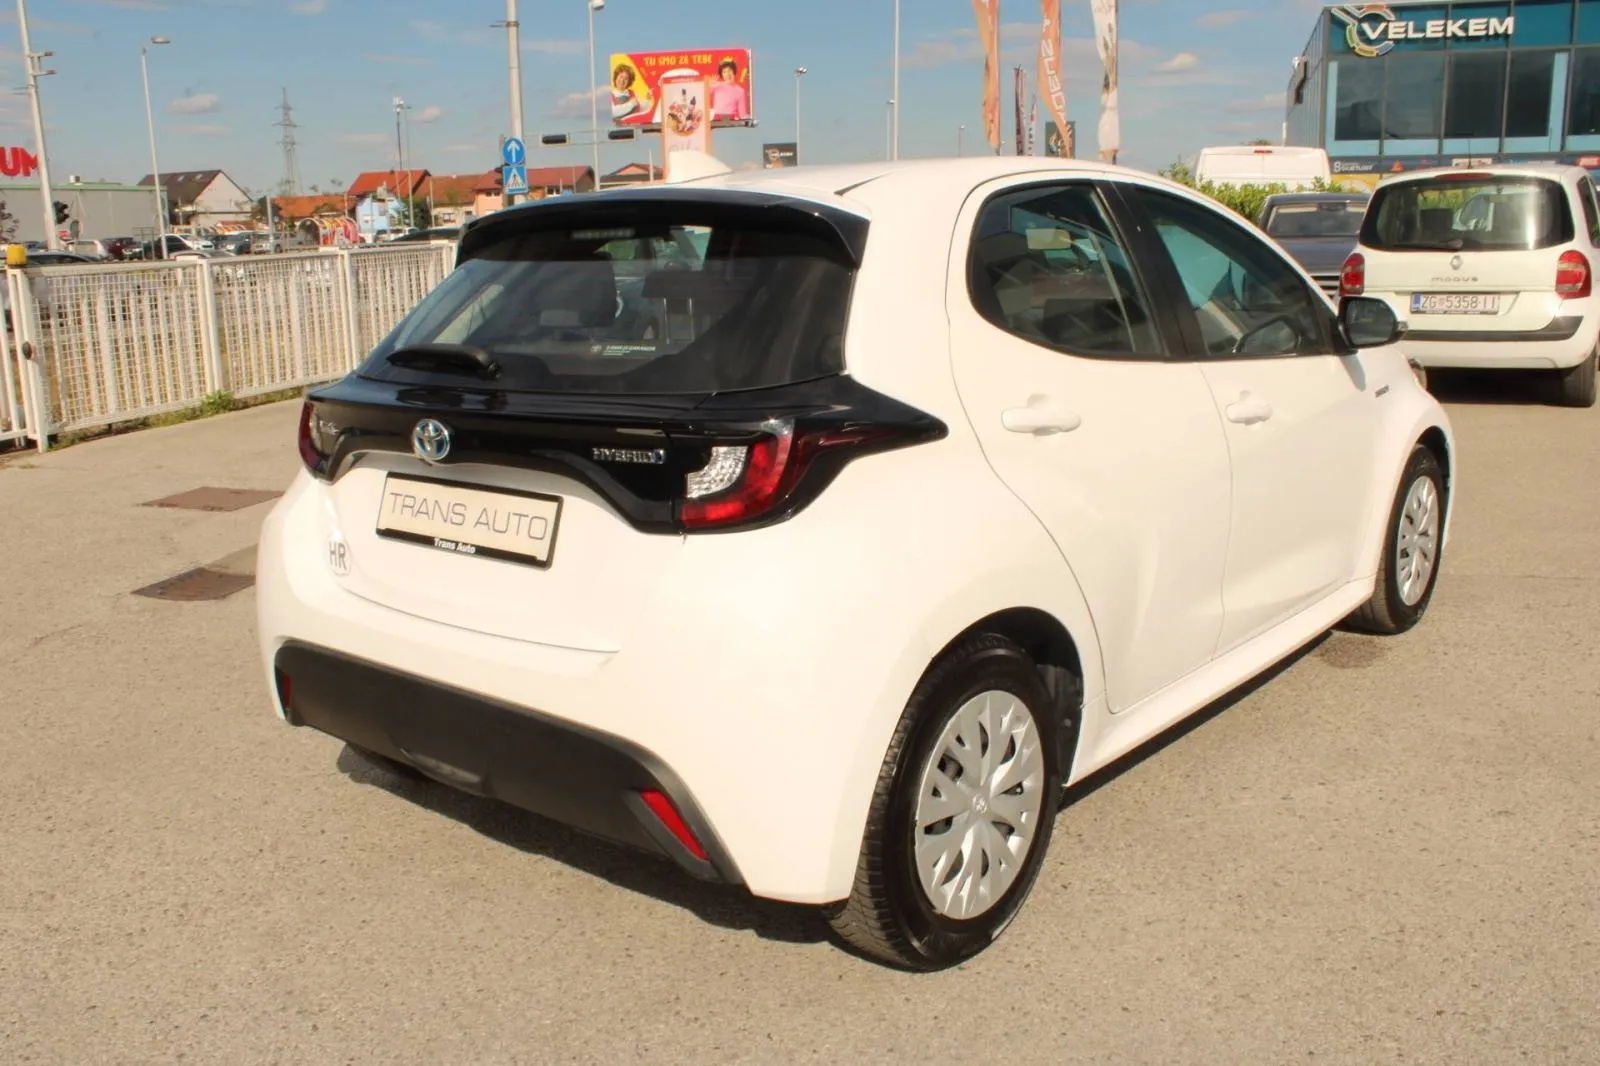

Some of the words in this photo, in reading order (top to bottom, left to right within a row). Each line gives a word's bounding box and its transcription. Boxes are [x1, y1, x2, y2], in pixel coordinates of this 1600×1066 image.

[1361, 16, 1515, 40] VELEKEM
[1422, 295, 1437, 309] ZG
[592, 447, 653, 463] HYBRID
[390, 492, 467, 526] TRANS
[473, 507, 548, 541] AUTO
[434, 537, 456, 551] Trans
[456, 542, 476, 554] Auto
[328, 541, 347, 571] HR
